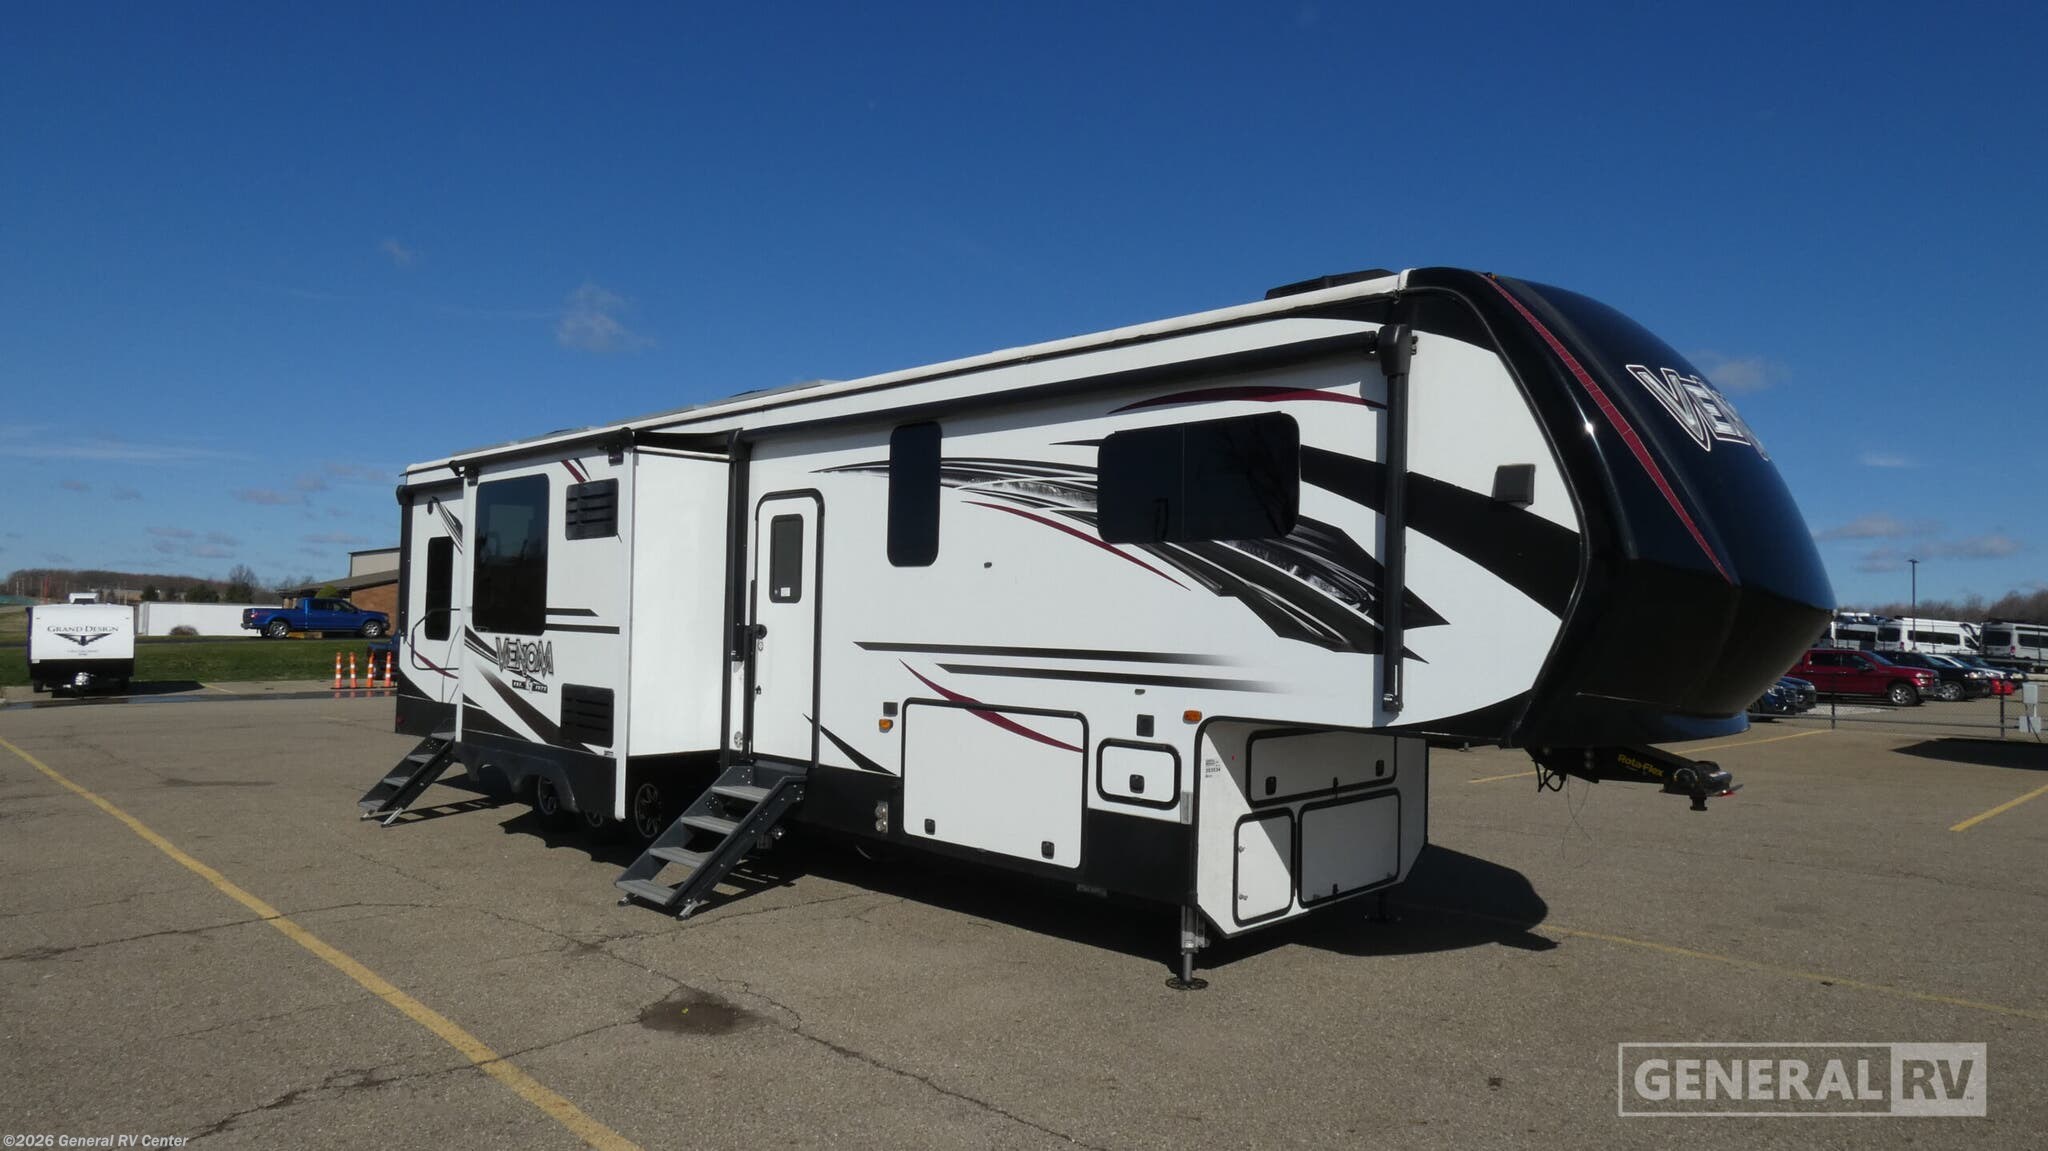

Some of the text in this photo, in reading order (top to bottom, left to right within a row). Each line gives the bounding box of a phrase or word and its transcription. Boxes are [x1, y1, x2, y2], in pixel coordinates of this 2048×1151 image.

[47, 625, 119, 633] GRAND DESIGN
[495, 636, 554, 679] VENOM
